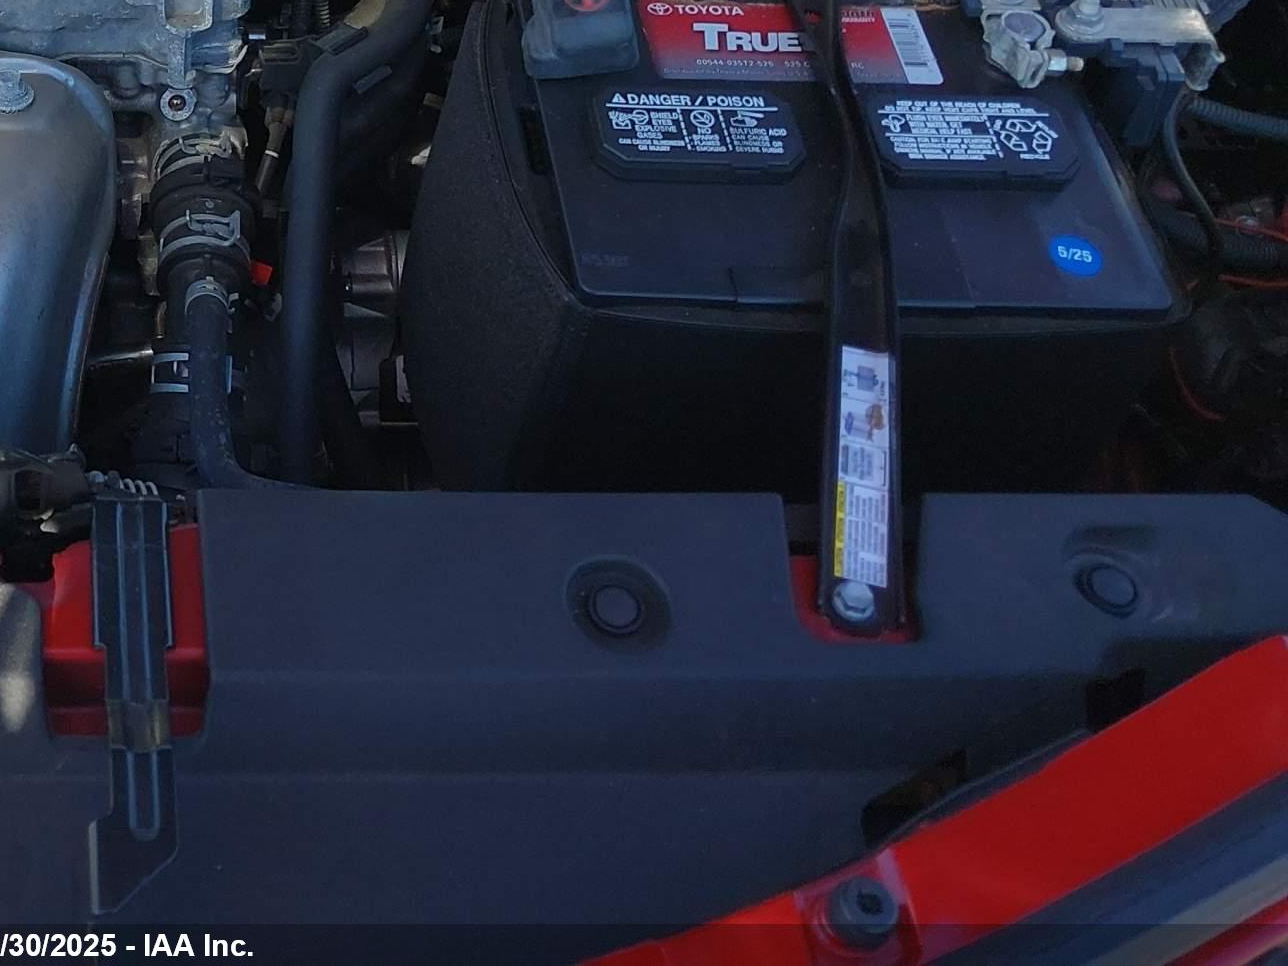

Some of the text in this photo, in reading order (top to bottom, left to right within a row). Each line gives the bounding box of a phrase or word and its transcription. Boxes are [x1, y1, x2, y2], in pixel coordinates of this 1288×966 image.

[674, 4, 744, 16] TOYOTA
[693, 22, 804, 53] TRUE
[627, 94, 764, 107] DANGER / POISON
